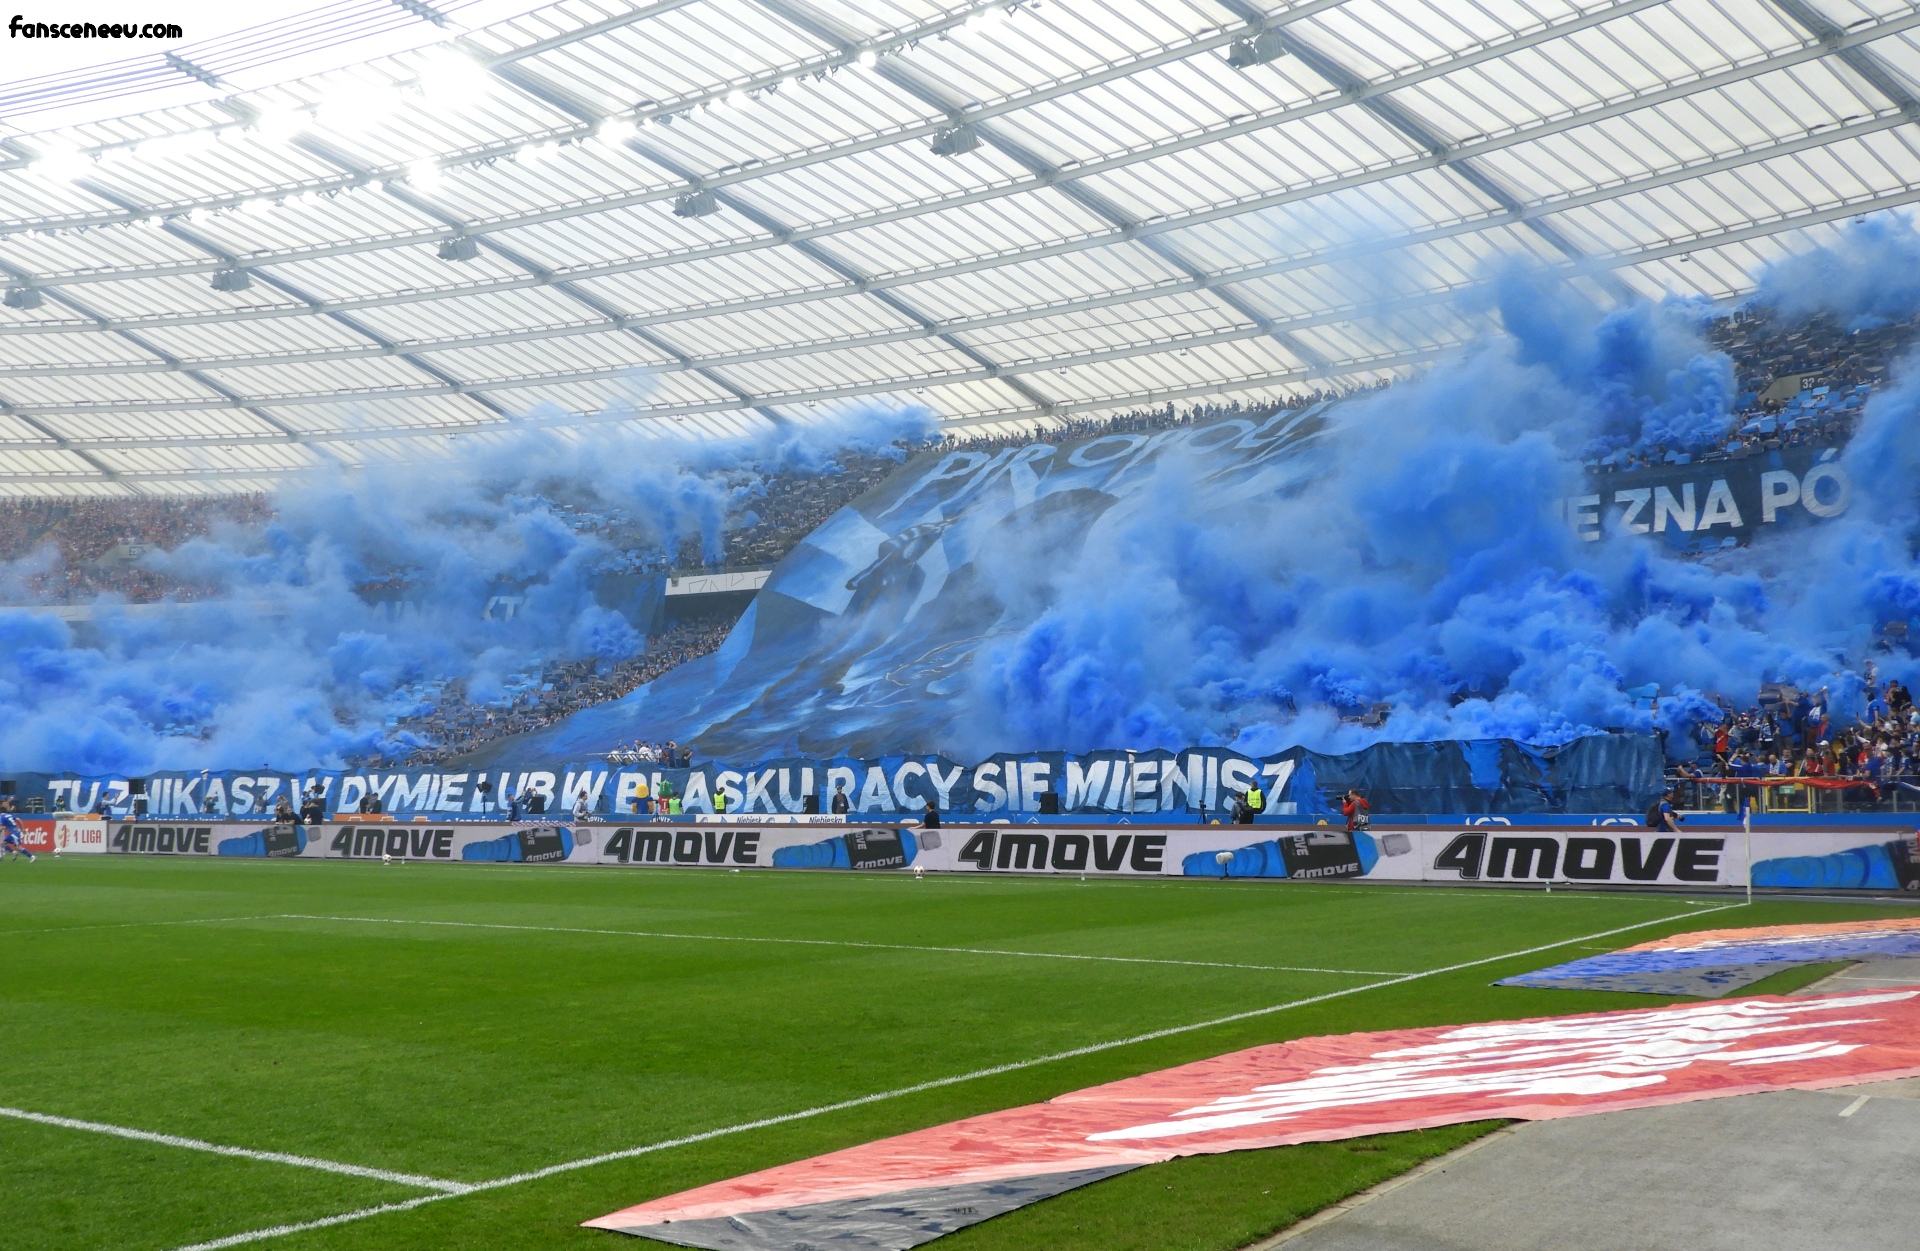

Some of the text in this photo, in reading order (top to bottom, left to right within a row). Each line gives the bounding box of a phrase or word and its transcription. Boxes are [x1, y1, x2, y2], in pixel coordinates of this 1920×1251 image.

[1614, 478, 1744, 536] ZNA
[48, 780, 101, 814] TU
[337, 773, 468, 813] DYMIE
[470, 771, 556, 813] LUB
[561, 770, 608, 811] W
[827, 761, 964, 814] RACY
[1064, 753, 1298, 815] MIENISZ
[82, 830, 101, 843] LIGA
[112, 825, 212, 853] 4MOVE
[330, 826, 455, 857] 4MOVE
[603, 828, 761, 863] 4MOVE
[958, 830, 1168, 871] 4MOVE
[1433, 832, 1726, 881] 4MOVE
